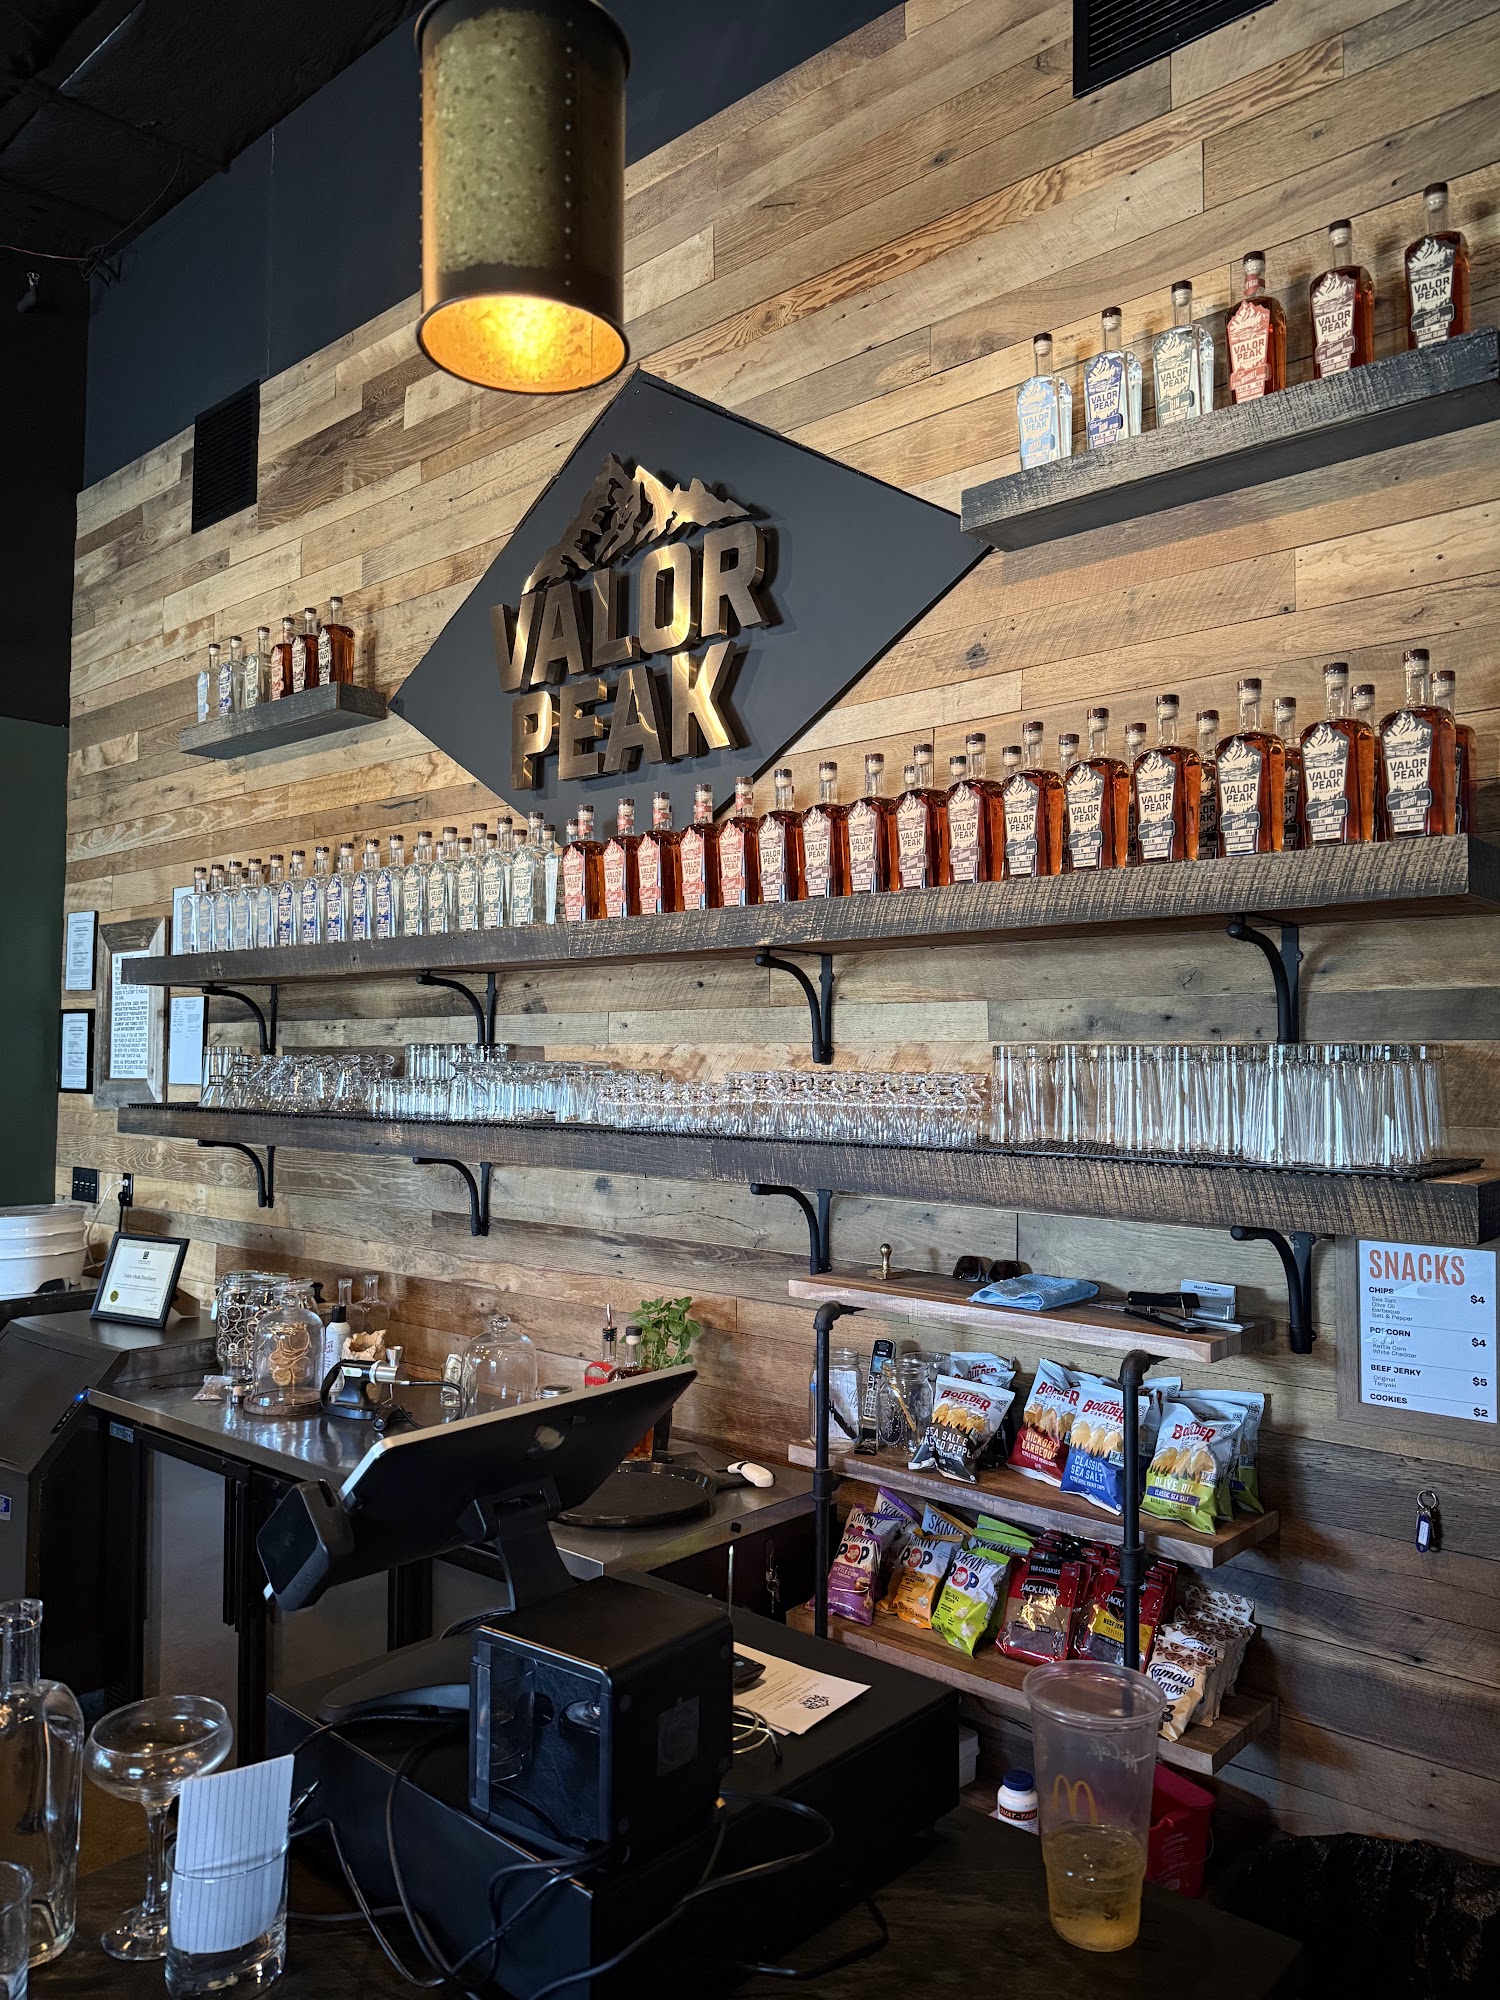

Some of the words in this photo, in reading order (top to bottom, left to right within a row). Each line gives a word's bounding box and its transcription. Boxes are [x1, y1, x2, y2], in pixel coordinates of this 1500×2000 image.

[1414, 276, 1450, 294] VALOR
[1417, 286, 1447, 302] PEAK
[1317, 309, 1351, 327] VALOR
[1321, 318, 1348, 335] PEAK
[1233, 338, 1265, 355] VALOR
[1237, 347, 1262, 362] PEAK
[1159, 366, 1189, 382] VALOR
[1163, 376, 1186, 389] PEAK
[1091, 390, 1118, 404] VALOR
[1094, 400, 1115, 412] PEAK
[1023, 411, 1049, 426] VALOR
[1026, 422, 1047, 432] PEAK
[490, 521, 768, 693] VALOR
[512, 641, 738, 790] PEAK
[1389, 757, 1427, 772] VALOR
[1308, 769, 1344, 782] VALOR
[1393, 768, 1424, 781] PEAK
[1223, 783, 1256, 795] VALOR
[1312, 778, 1340, 790] PEAK
[1141, 792, 1171, 804] VALOR
[1226, 792, 1253, 803] PEAK
[1071, 804, 1099, 815] VALOR
[1144, 801, 1169, 812] PEAK
[1007, 814, 1034, 825] VALOR
[1073, 812, 1097, 823] PEAK
[952, 821, 976, 832] VALOR
[1010, 822, 1031, 832] PEAK
[900, 830, 923, 841] VALOR
[954, 830, 974, 839] PEAK
[850, 836, 873, 846] VALOR
[903, 838, 921, 847] PEAK
[806, 842, 827, 852] VALOR
[852, 844, 871, 852] PEAK
[722, 855, 741, 863] VALOR
[761, 849, 781, 858] VALOR
[808, 850, 826, 858] PEAK
[724, 862, 739, 870] PEAK
[763, 857, 779, 865] PEAK
[1369, 1249, 1465, 1286] SNACKS
[1368, 1286, 1395, 1295] CHIPS
[1470, 1294, 1486, 1304] $4
[1371, 1307, 1401, 1316] Barbeque
[1391, 1314, 1414, 1322] Pepper
[1372, 1343, 1391, 1351] Kettle
[1471, 1337, 1487, 1348] $4
[1372, 1348, 1391, 1356] White
[1391, 1350, 1417, 1359] Cheddar
[1370, 1364, 1391, 1373] BEEF
[1393, 1366, 1421, 1376] JERKY
[1373, 1375, 1396, 1383] Original
[1373, 1380, 1397, 1389] Teriyaki
[1472, 1376, 1488, 1387] $5
[941, 1389, 992, 1412] BOULDER
[1370, 1393, 1408, 1404] COOKIES
[1473, 1407, 1489, 1418] $2
[925, 1426, 939, 1438] SEA
[941, 1430, 961, 1443] SALT
[1025, 1431, 1060, 1451] HICKORY
[1074, 1455, 1103, 1472] CLASSIC
[1070, 1464, 1084, 1477] SEA
[1085, 1470, 1104, 1483] SALT
[1154, 1477, 1178, 1491] OLIVE
[1181, 1483, 1194, 1494] OIL
[1170, 1493, 1179, 1501] SEA
[1179, 1495, 1190, 1503] SALT
[834, 1543, 870, 1564] POP
[901, 1548, 933, 1569] POP
[1019, 1582, 1039, 1594] JACK
[1105, 1593, 1123, 1607] JACK
[1103, 1617, 1115, 1627] BEEF
[1149, 1663, 1195, 1687] Famous
